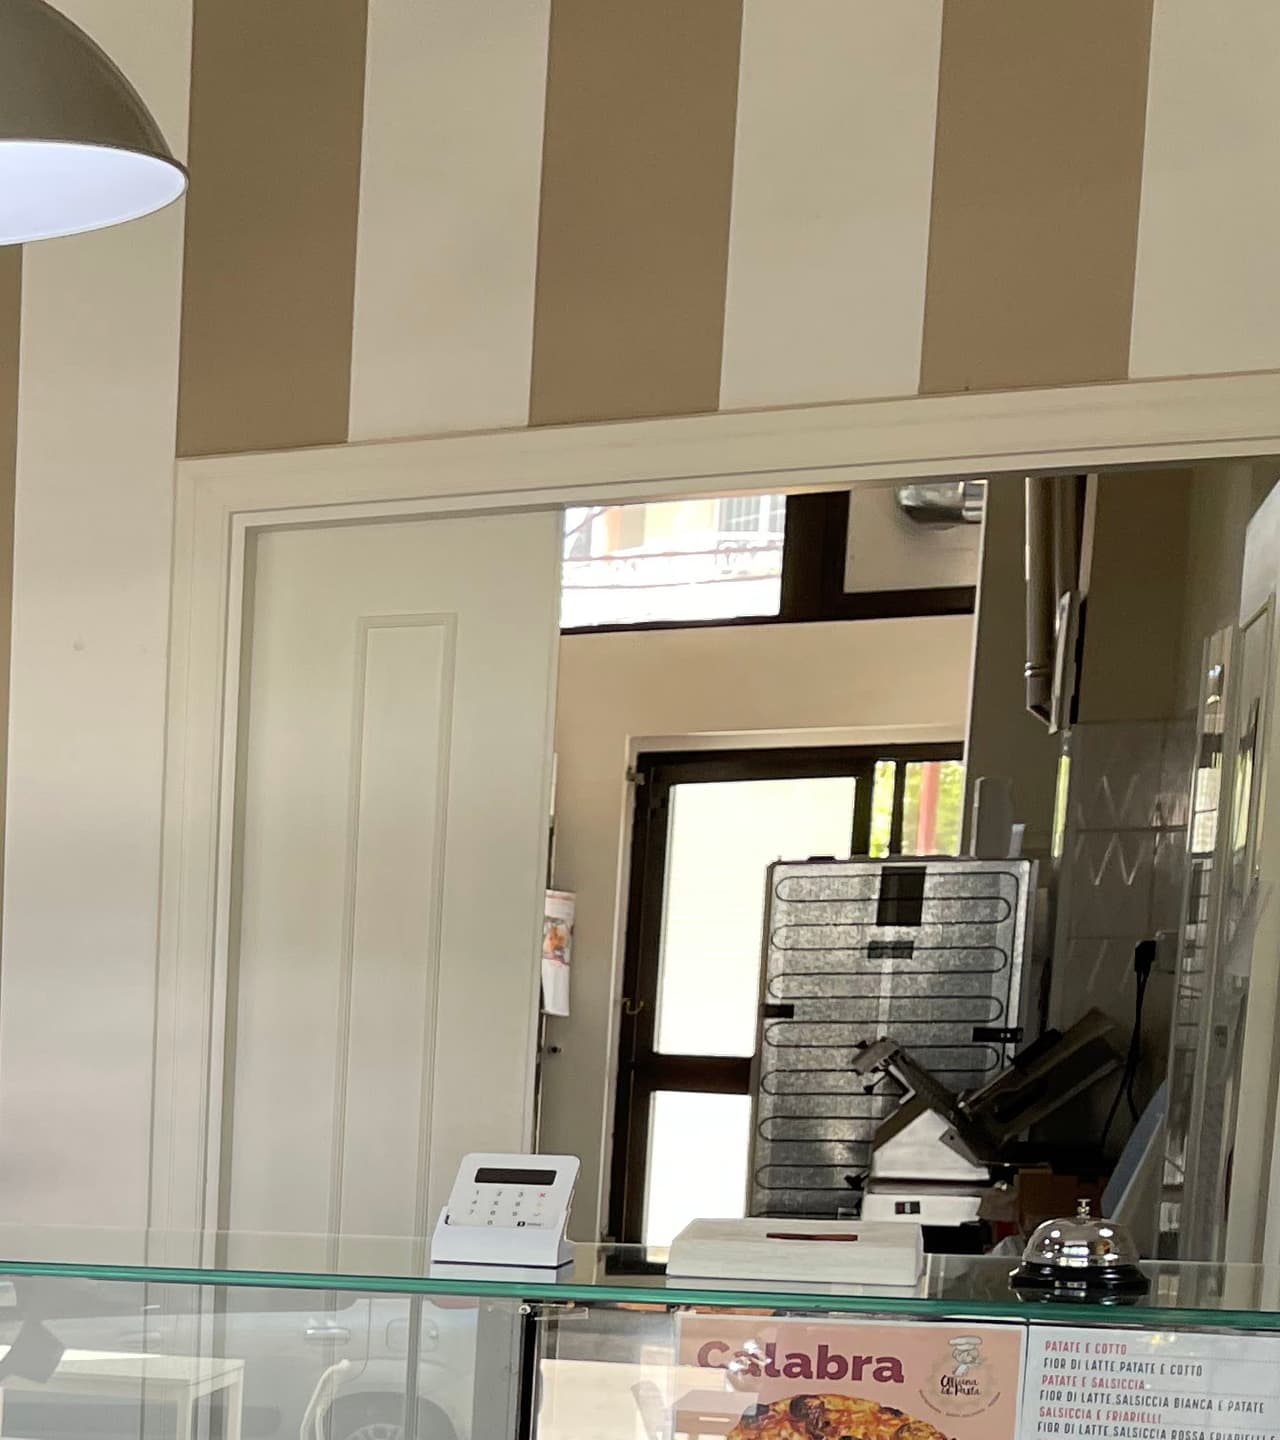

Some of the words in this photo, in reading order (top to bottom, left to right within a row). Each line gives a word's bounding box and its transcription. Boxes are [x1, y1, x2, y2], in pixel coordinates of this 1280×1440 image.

[1045, 1341, 1080, 1353] PATATE
[1085, 1342, 1091, 1354] E
[1095, 1343, 1127, 1355] COTTO
[697, 1340, 905, 1384] Calabra
[1043, 1358, 1066, 1369] FIOR
[1071, 1359, 1081, 1369] DI
[1160, 1363, 1166, 1375] E
[1170, 1364, 1203, 1377] COTTO
[1041, 1375, 1077, 1387] PATATE
[1082, 1376, 1087, 1388] E
[1091, 1377, 1145, 1390] SALSICCIA
[1040, 1390, 1062, 1401] FIOR
[1067, 1391, 1077, 1402] DI
[1174, 1397, 1213, 1410] BIANCA
[1218, 1400, 1223, 1412] E
[1228, 1401, 1264, 1414] PATATE
[1039, 1406, 1092, 1420] SALSICCIA
[1096, 1409, 1102, 1420] E
[1106, 1411, 1162, 1424] FRIARIELLI
[1037, 1422, 1060, 1433] FIOR
[1064, 1423, 1074, 1434] DI
